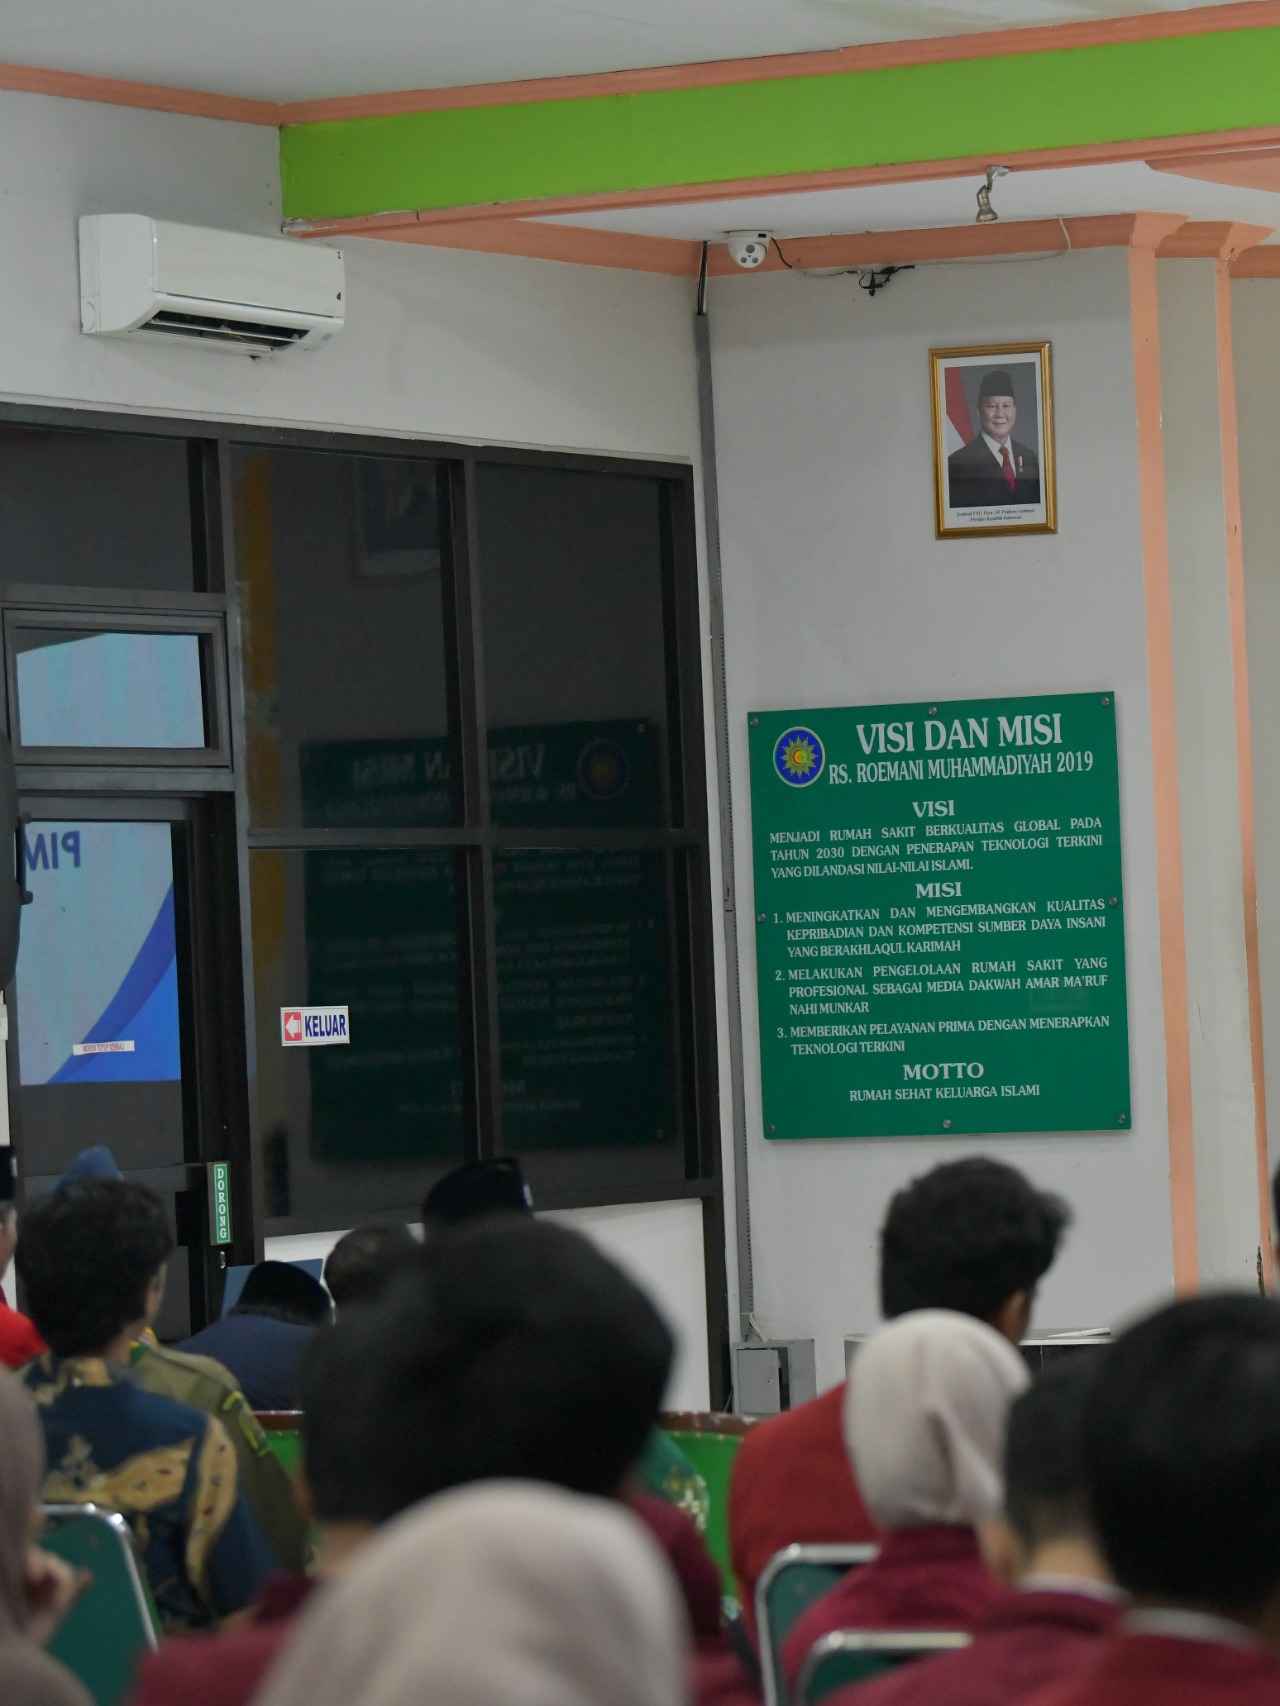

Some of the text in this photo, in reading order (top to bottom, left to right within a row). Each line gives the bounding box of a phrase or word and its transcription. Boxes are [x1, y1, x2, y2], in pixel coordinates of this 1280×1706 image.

[855, 712, 1063, 755] VISI DAN MISI
[829, 750, 1094, 784] RS. ROEMANI MUHAMMADIYAH 2019
[911, 799, 955, 818] VISI
[769, 816, 1102, 844] MENJADI RUMAH SAKIT BERKUALITAS GLOBAL PADA
[770, 834, 1103, 861] TAHUN 2030 DENGAN PENERAPAN TEKNOLOGI TERKINI
[770, 858, 974, 879] YANG DILANDASI NILAI-NILAI ISLAMI.
[914, 881, 962, 899] MISI
[785, 907, 880, 923] MENINGKATKAN
[890, 906, 916, 919] DAN
[925, 901, 1036, 917] MENGEMBANGKAN
[1047, 898, 1105, 912] KUALITAS
[786, 916, 1106, 941] KEPRIBADIAN DAN KOMPETENSI SUMBER DAYA INSANI
[787, 939, 961, 958] YANG BERAKHLAQUL KARIMAH
[787, 966, 863, 980] MELAKUKAN
[872, 962, 961, 977] PENGELOLAAN
[971, 960, 1016, 973] RUMAH
[1026, 958, 1064, 971] SAKIT
[1073, 956, 1108, 969] YANG
[788, 974, 1108, 998] PROFESIONAL SEBAGAI MEDIA DAKWAH AMAR MA'RUF
[789, 1001, 870, 1016] NAHI MUNKAR
[304, 1014, 347, 1037] KELUAR
[790, 1023, 867, 1037] MEMBERIKAN
[869, 1021, 935, 1035] PELAYANAN
[937, 1020, 976, 1032] PRIMA
[977, 1018, 1027, 1031] DENGAN
[1029, 1015, 1110, 1029] MENERAPKAN
[790, 1040, 905, 1056] TEKNOLOGI TERKINI
[902, 1061, 985, 1080] MOTTO
[849, 1083, 1040, 1103] RUMAH SEHAT KELUARGA ISLAMI
[216, 1167, 227, 1239] DORONG
